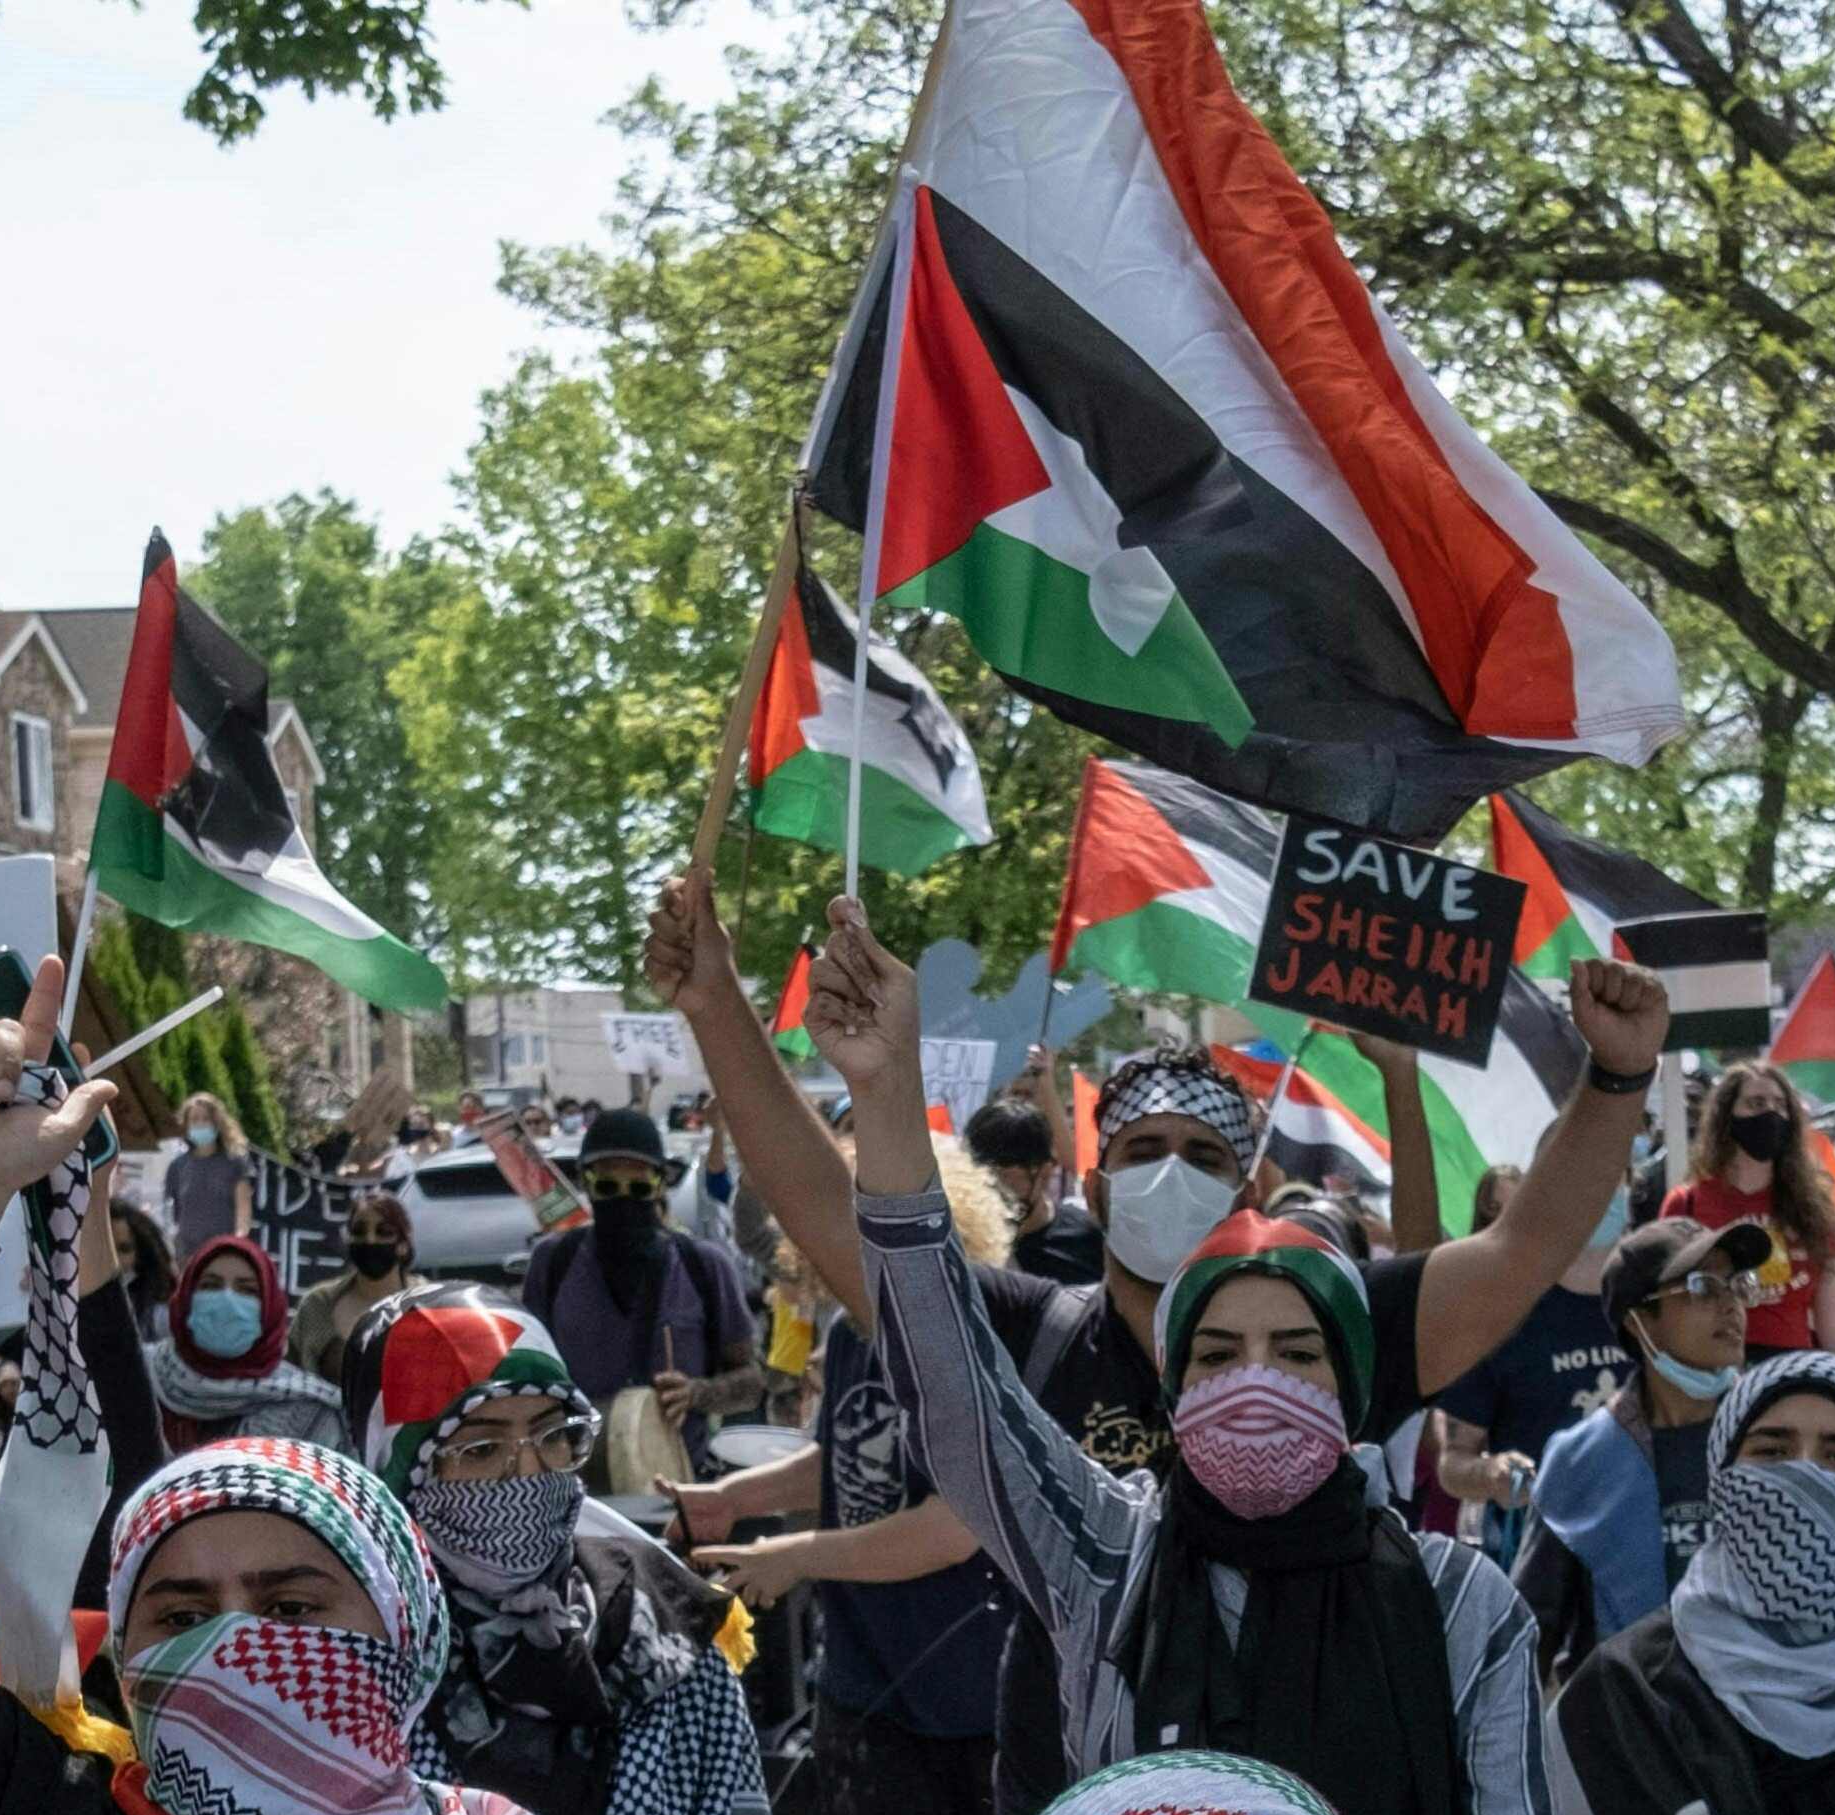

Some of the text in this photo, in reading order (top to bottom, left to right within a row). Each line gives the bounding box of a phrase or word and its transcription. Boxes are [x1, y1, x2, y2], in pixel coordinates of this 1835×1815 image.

[1296, 829, 1480, 922] SAVE
[1284, 893, 1493, 993] SHEIKH
[1267, 946, 1469, 1039] JARRAH
